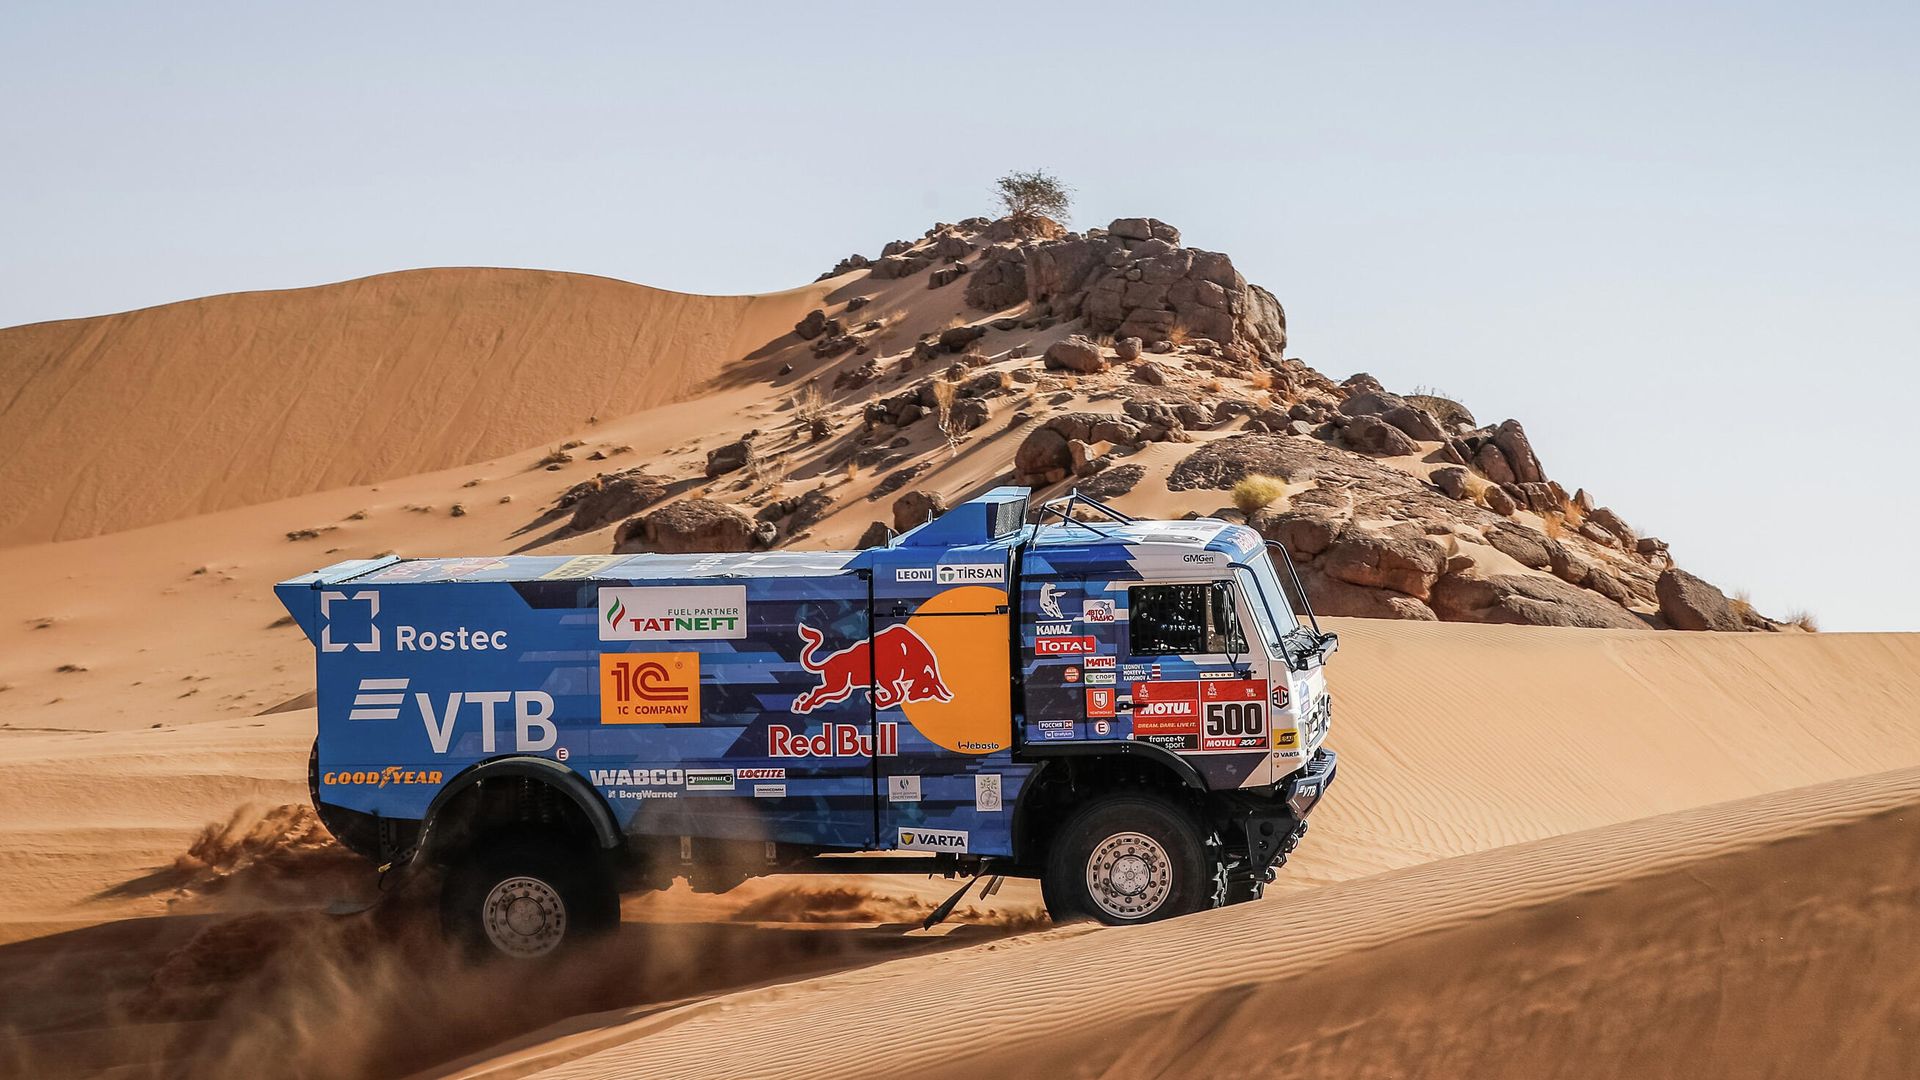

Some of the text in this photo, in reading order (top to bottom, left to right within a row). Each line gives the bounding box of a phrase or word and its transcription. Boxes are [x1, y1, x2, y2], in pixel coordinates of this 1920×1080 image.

[897, 570, 932, 580] LEONI
[667, 607, 739, 616] FUEL PARTNER
[630, 617, 739, 631] TATNEFT
[1036, 624, 1073, 635] KAMAZ
[396, 625, 508, 651] Rostec
[618, 704, 689, 715] 1C COMPANY
[1141, 702, 1191, 715] MOTUL
[415, 690, 558, 753] VTB
[1206, 703, 1263, 736] 500
[768, 722, 899, 758] Red Bull
[1164, 741, 1185, 750] sport
[1206, 738, 1265, 747] MOTUL 300V
[323, 767, 443, 787] GOODYEAR
[589, 769, 684, 787] WABCO
[738, 769, 784, 779] LOCTITE
[619, 790, 678, 800] BorgWarner
[1303, 784, 1317, 798] VTB
[917, 833, 965, 847] VARTA
